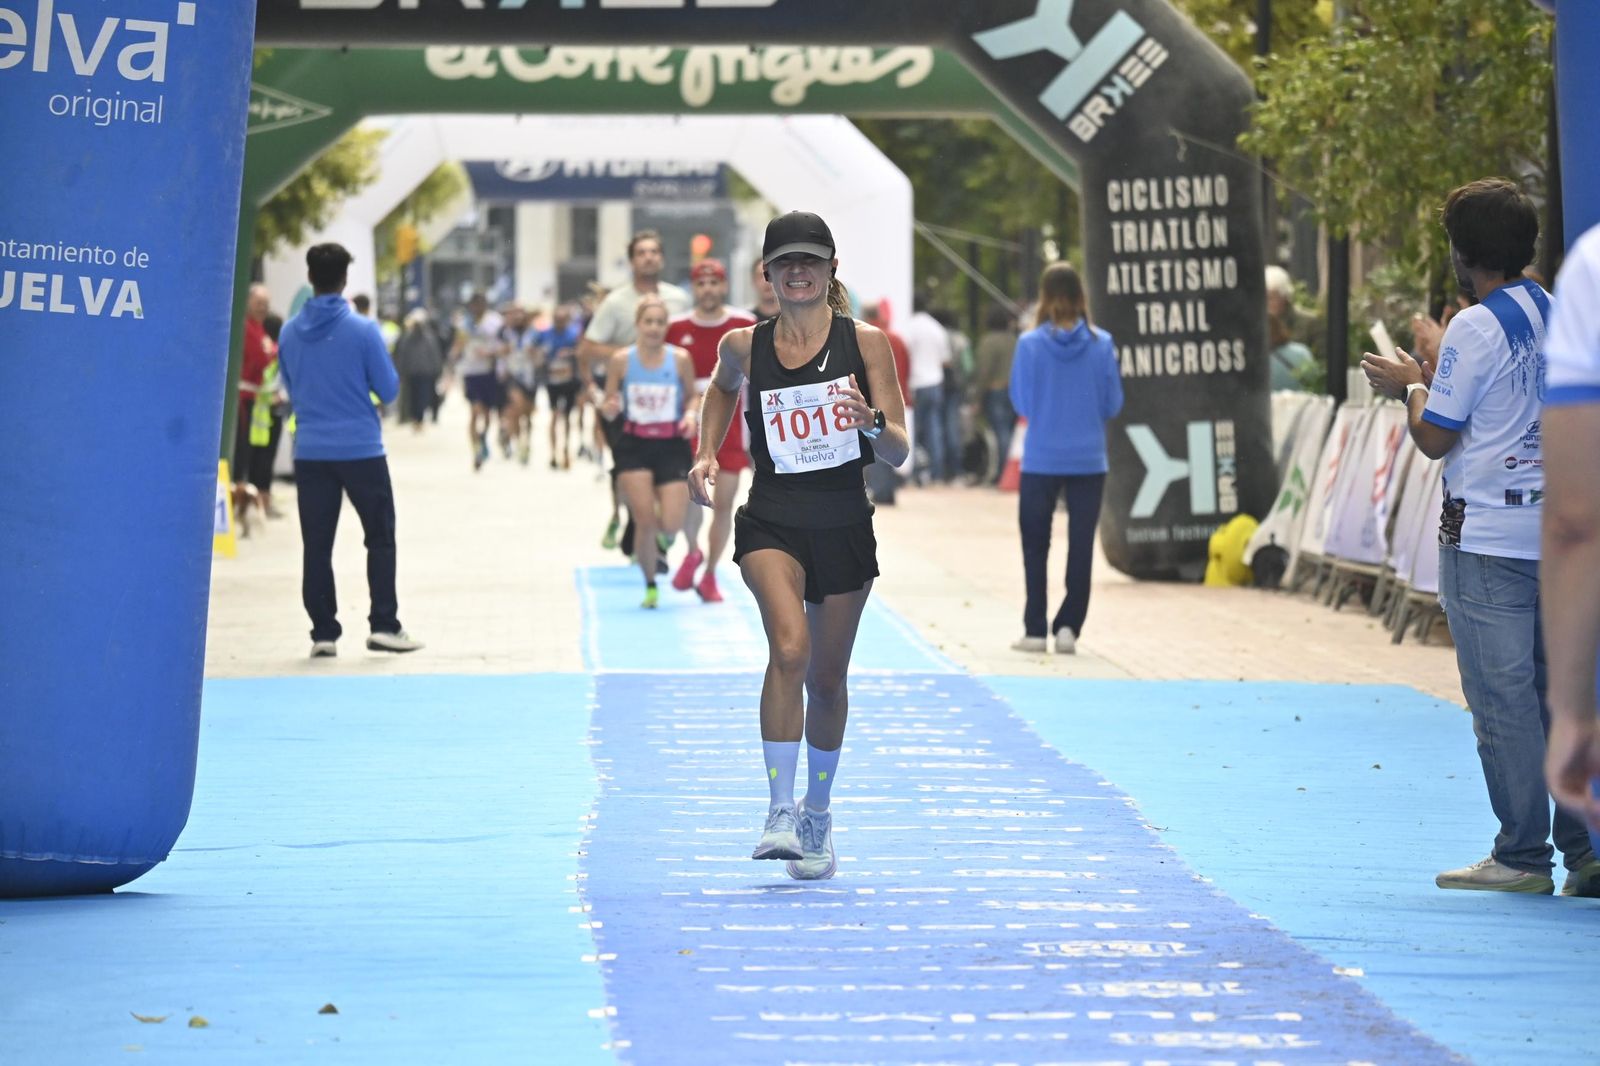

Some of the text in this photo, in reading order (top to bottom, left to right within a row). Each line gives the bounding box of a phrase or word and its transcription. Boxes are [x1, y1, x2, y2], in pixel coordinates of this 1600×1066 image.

[49, 88, 163, 126] original
[1107, 174, 1229, 213] CICLISMO
[1111, 212, 1229, 254] TRIATLÓN
[123, 246, 150, 268] de
[1106, 255, 1238, 295] ATLETISMO
[1136, 301, 1211, 335] TRAIL
[769, 401, 852, 443] 1018
[795, 450, 838, 465] Huelva
